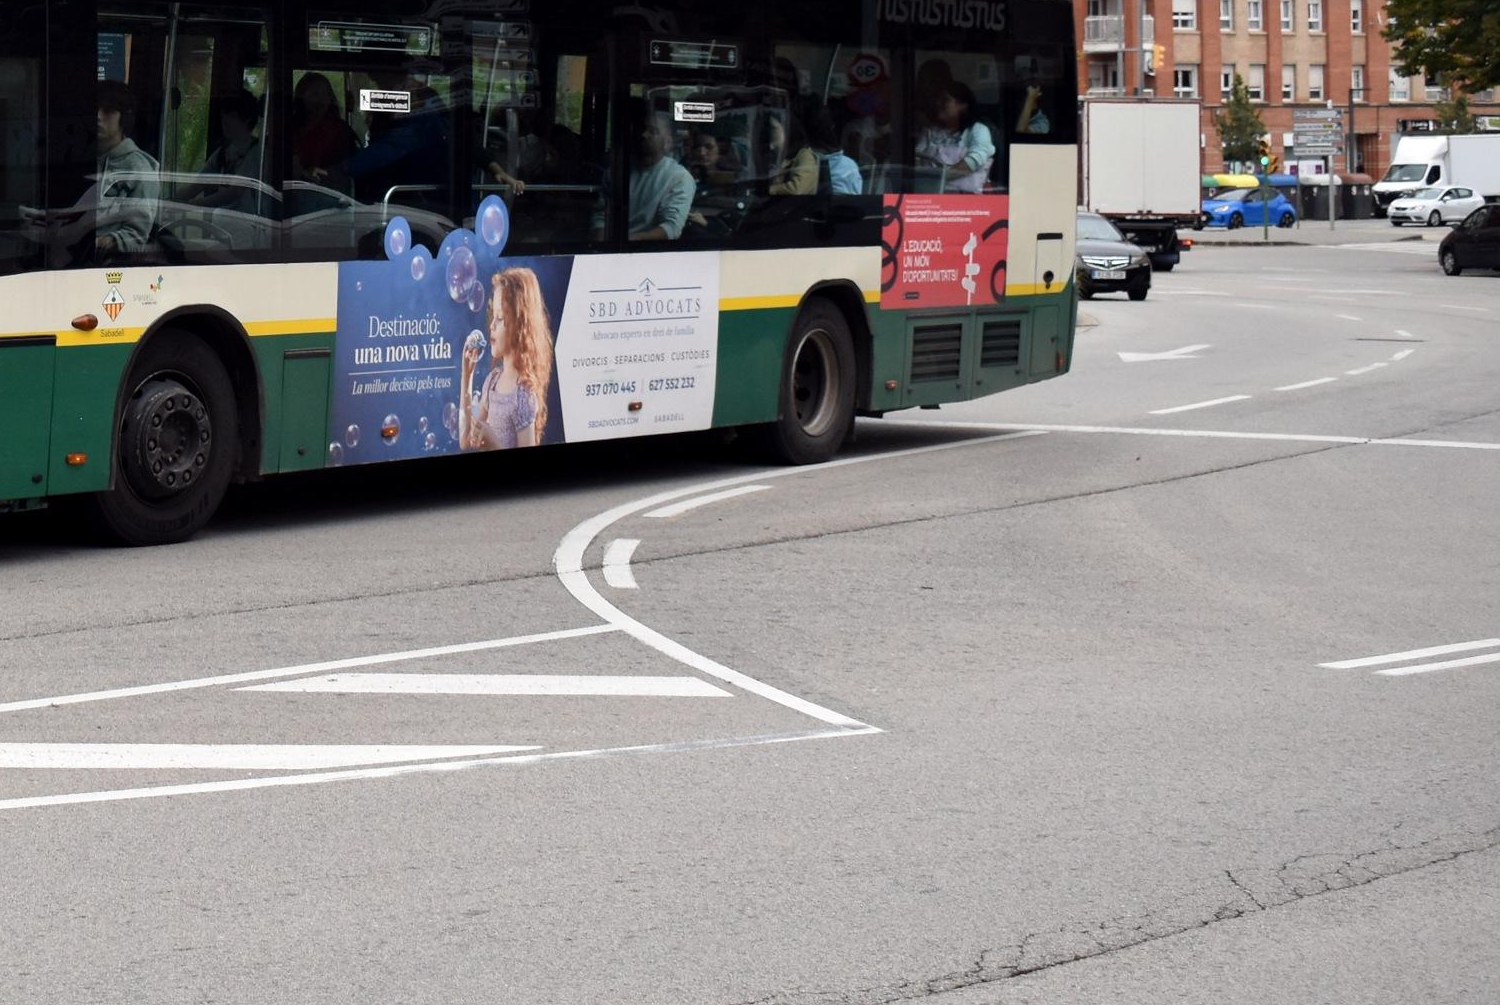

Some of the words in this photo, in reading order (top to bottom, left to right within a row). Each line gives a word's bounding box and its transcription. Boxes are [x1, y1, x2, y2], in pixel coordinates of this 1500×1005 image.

[903, 256, 913, 268] UN
[589, 302, 618, 318] SBD
[625, 298, 702, 317] ADVOCATS
[368, 313, 441, 338] Destinació:
[355, 347, 382, 365] una
[386, 344, 420, 363] nova
[423, 336, 452, 360] vida
[572, 357, 608, 368] DIVORCIS
[614, 352, 666, 365] SEPARACIONS
[352, 380, 363, 395] La
[364, 378, 389, 394] millor
[417, 375, 434, 394] pels
[434, 376, 452, 389] teus
[585, 384, 602, 397] 937
[602, 382, 619, 396] 070
[620, 380, 637, 393] 445
[648, 379, 664, 391] 627
[665, 378, 679, 390] 552
[680, 376, 696, 389] 232
